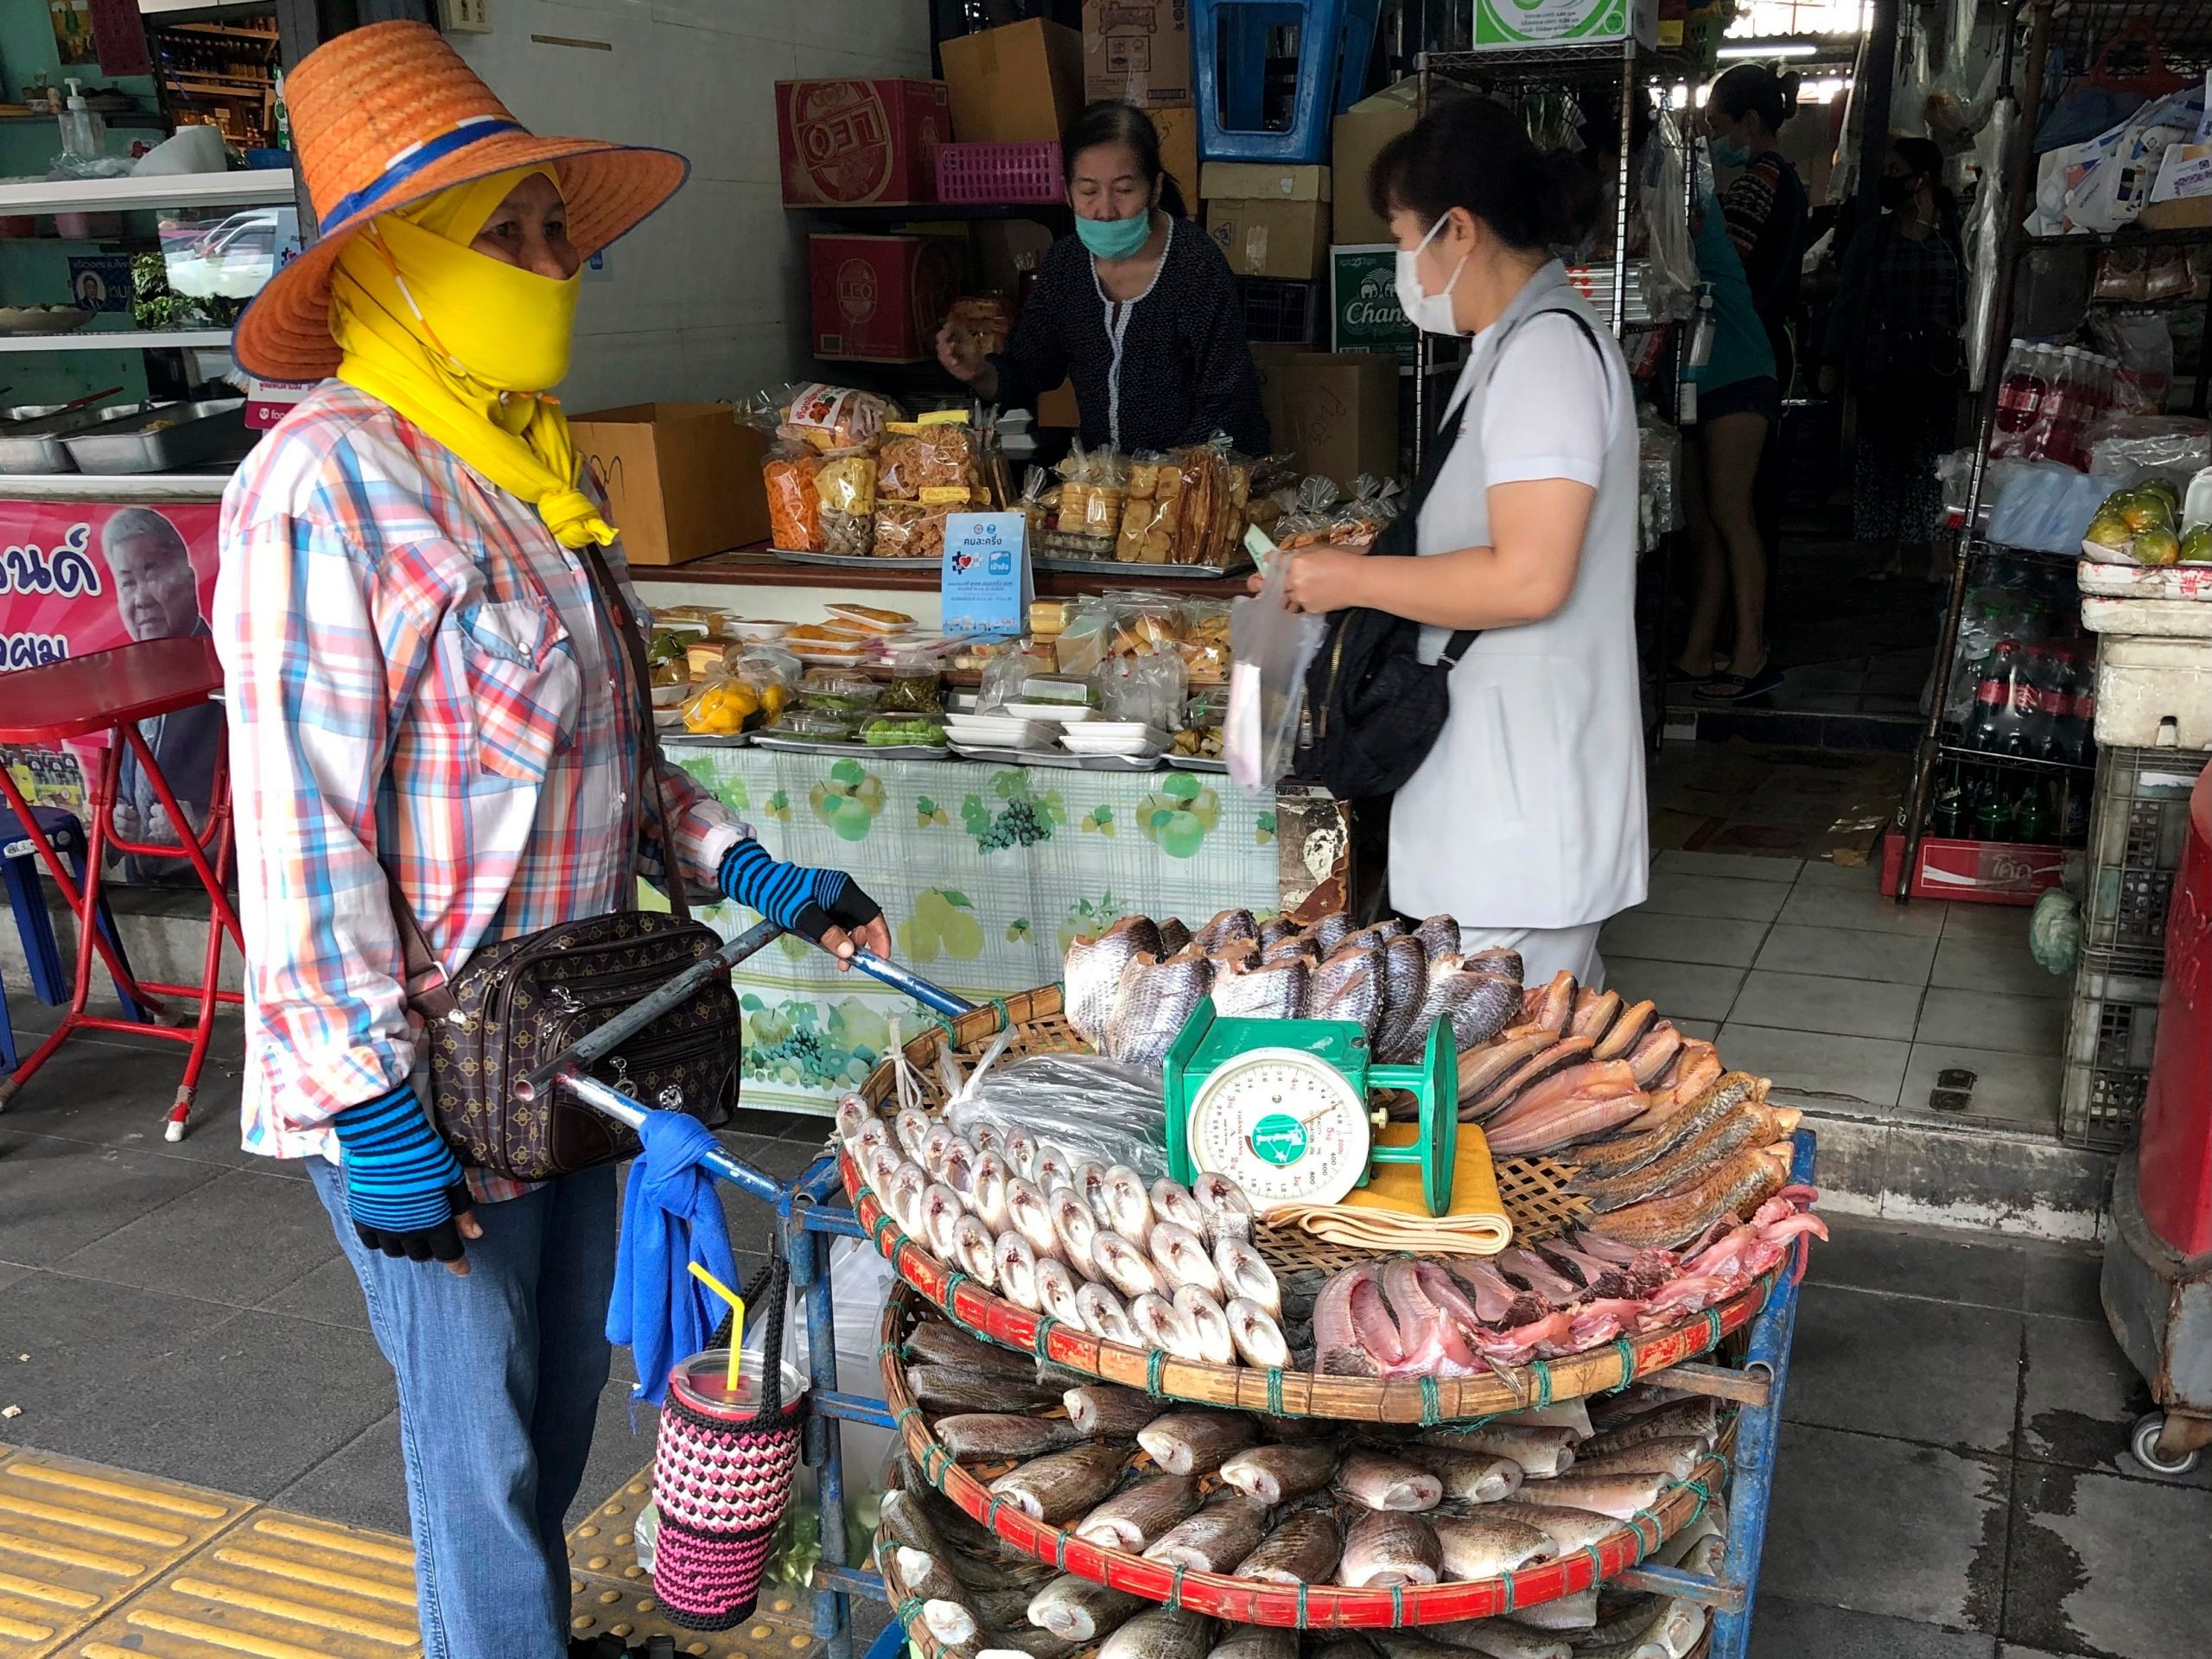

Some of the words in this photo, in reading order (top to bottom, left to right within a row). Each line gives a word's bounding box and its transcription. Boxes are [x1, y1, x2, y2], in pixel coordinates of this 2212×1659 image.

[839, 282, 873, 301] LEO
[963, 534, 1002, 546] คนละครึ่ง
[0, 525, 99, 594] นด์
[0, 636, 67, 669] ผม
